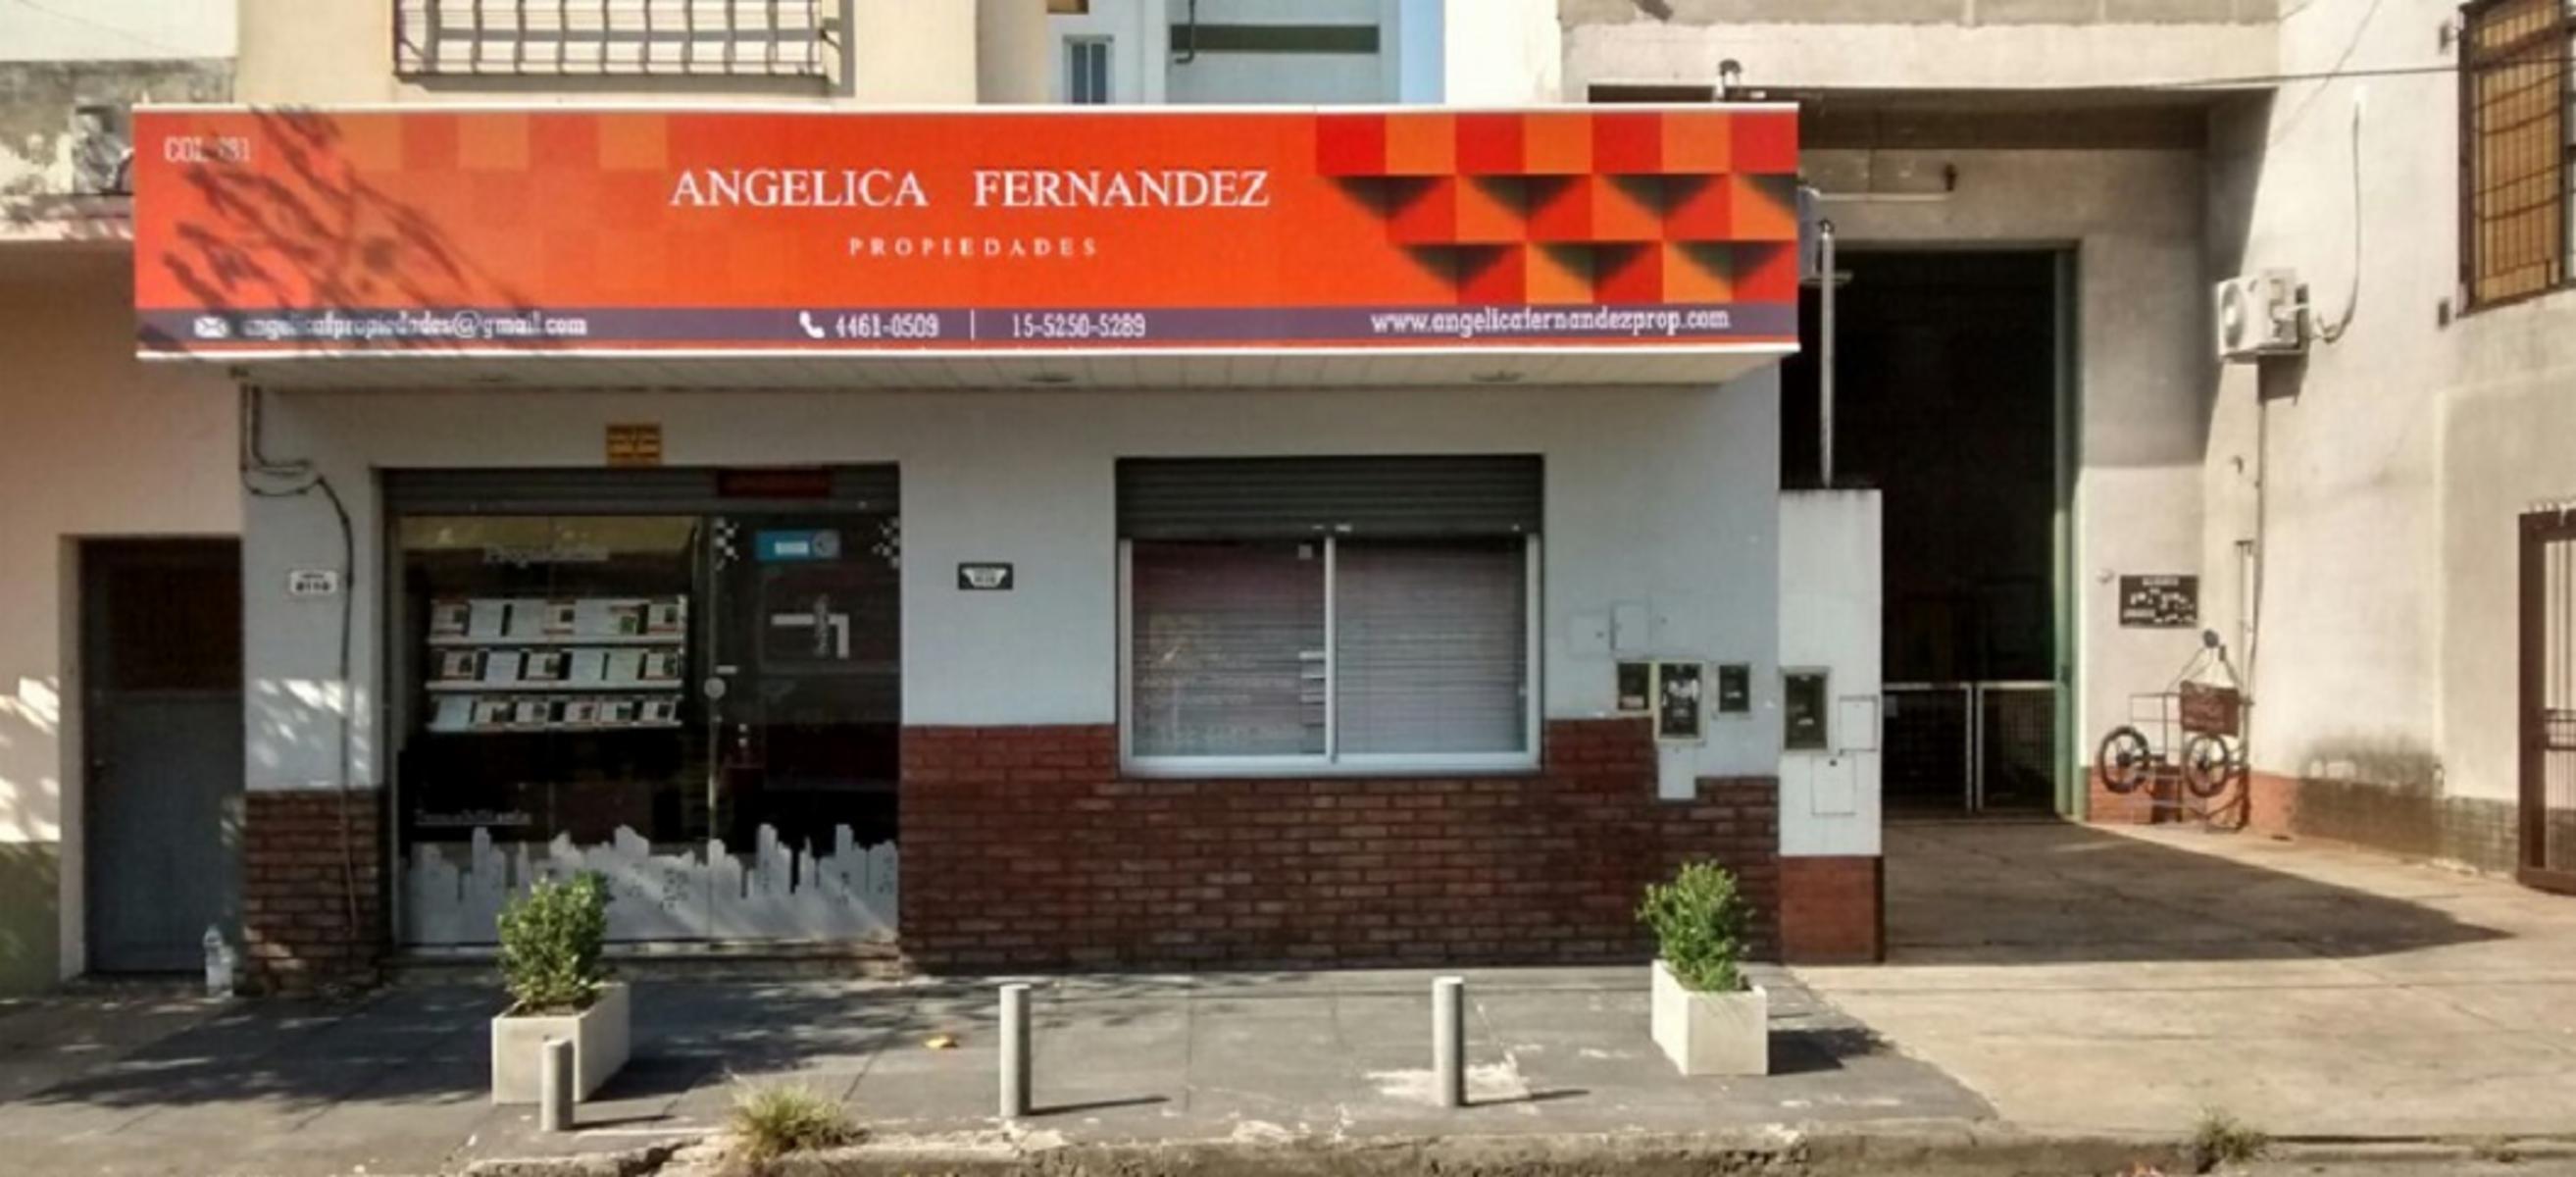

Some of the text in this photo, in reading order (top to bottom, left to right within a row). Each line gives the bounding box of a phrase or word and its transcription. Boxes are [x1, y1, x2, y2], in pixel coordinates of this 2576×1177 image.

[669, 170, 1270, 208] ANGELICA FERNANDEZ
[848, 236, 1097, 258] PROPIEDADES
[835, 313, 940, 338] 4461-0509
[1013, 312, 1146, 337] 15-5250-5289
[1371, 305, 1731, 337] www.angelicafernandezprop.com
